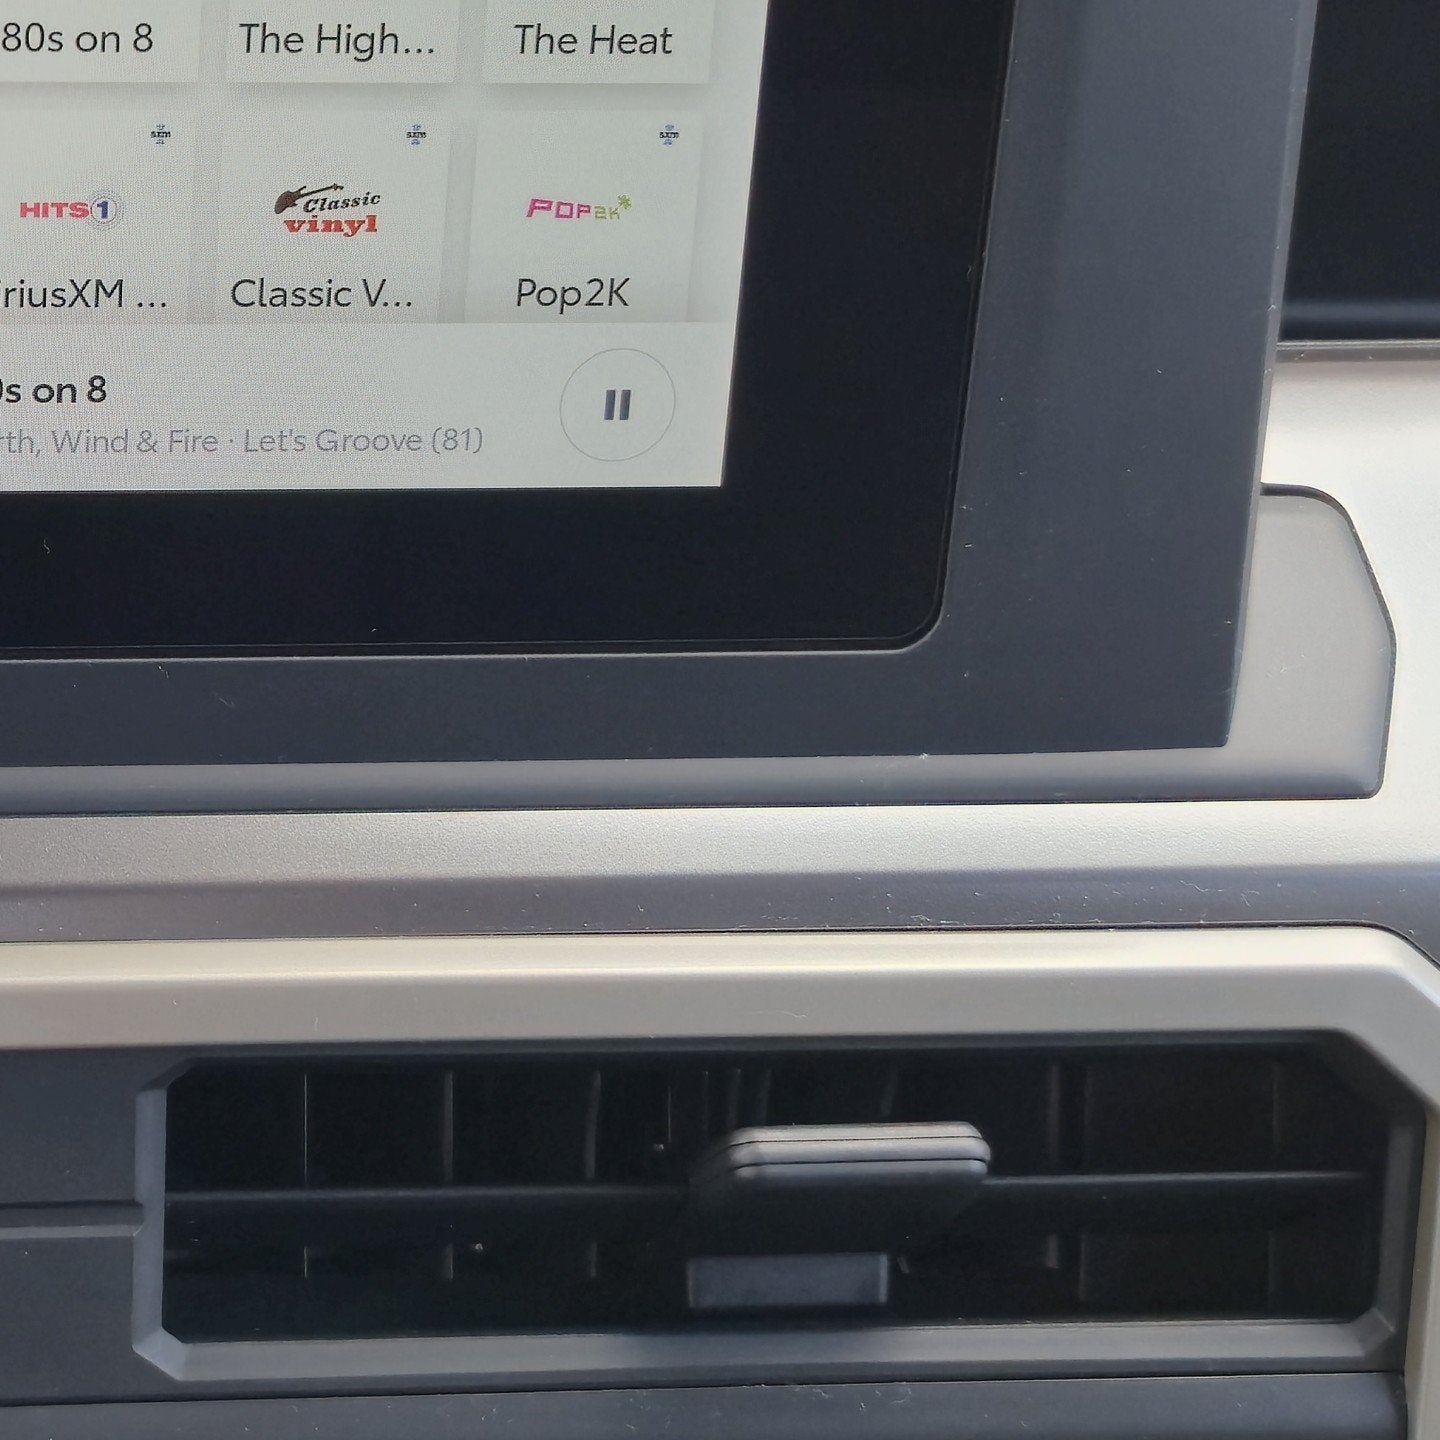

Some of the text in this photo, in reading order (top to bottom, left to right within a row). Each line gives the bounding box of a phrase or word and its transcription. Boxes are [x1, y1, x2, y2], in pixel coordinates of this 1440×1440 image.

[1, 22, 154, 53] 80s on 8
[239, 22, 304, 54] The
[513, 22, 673, 55] The Heat
[303, 191, 381, 213] Classic
[283, 214, 378, 238] vinyl
[230, 277, 352, 308] Classic
[517, 277, 631, 315] Pop2K
[31, 381, 78, 404] on
[86, 375, 108, 404] 8
[51, 428, 129, 454] Wind
[136, 429, 161, 453] &
[168, 428, 219, 453] Fire
[244, 428, 307, 453] Let's
[316, 428, 422, 453] Groove
[432, 426, 484, 455] (81)
